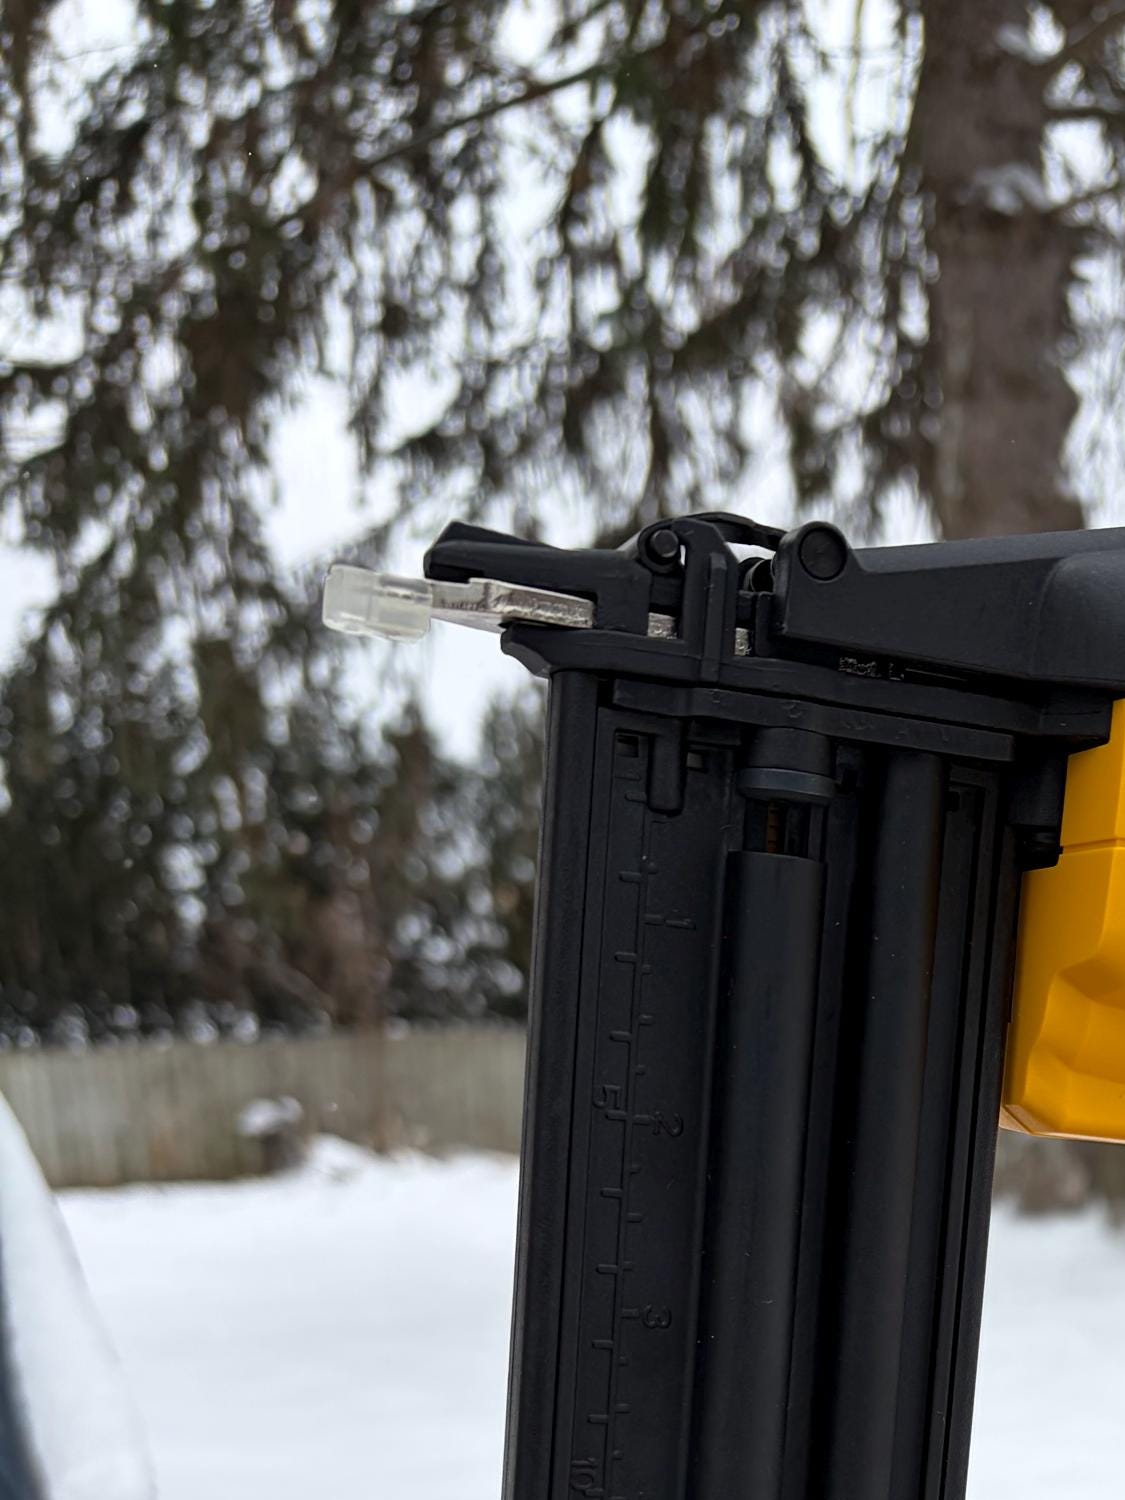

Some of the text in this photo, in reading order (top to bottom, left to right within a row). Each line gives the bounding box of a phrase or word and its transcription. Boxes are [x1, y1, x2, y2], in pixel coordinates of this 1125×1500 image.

[592, 1084, 622, 1110] 5
[653, 1112, 684, 1138] 2
[642, 1304, 672, 1329] 3
[570, 1457, 597, 1489] 10
